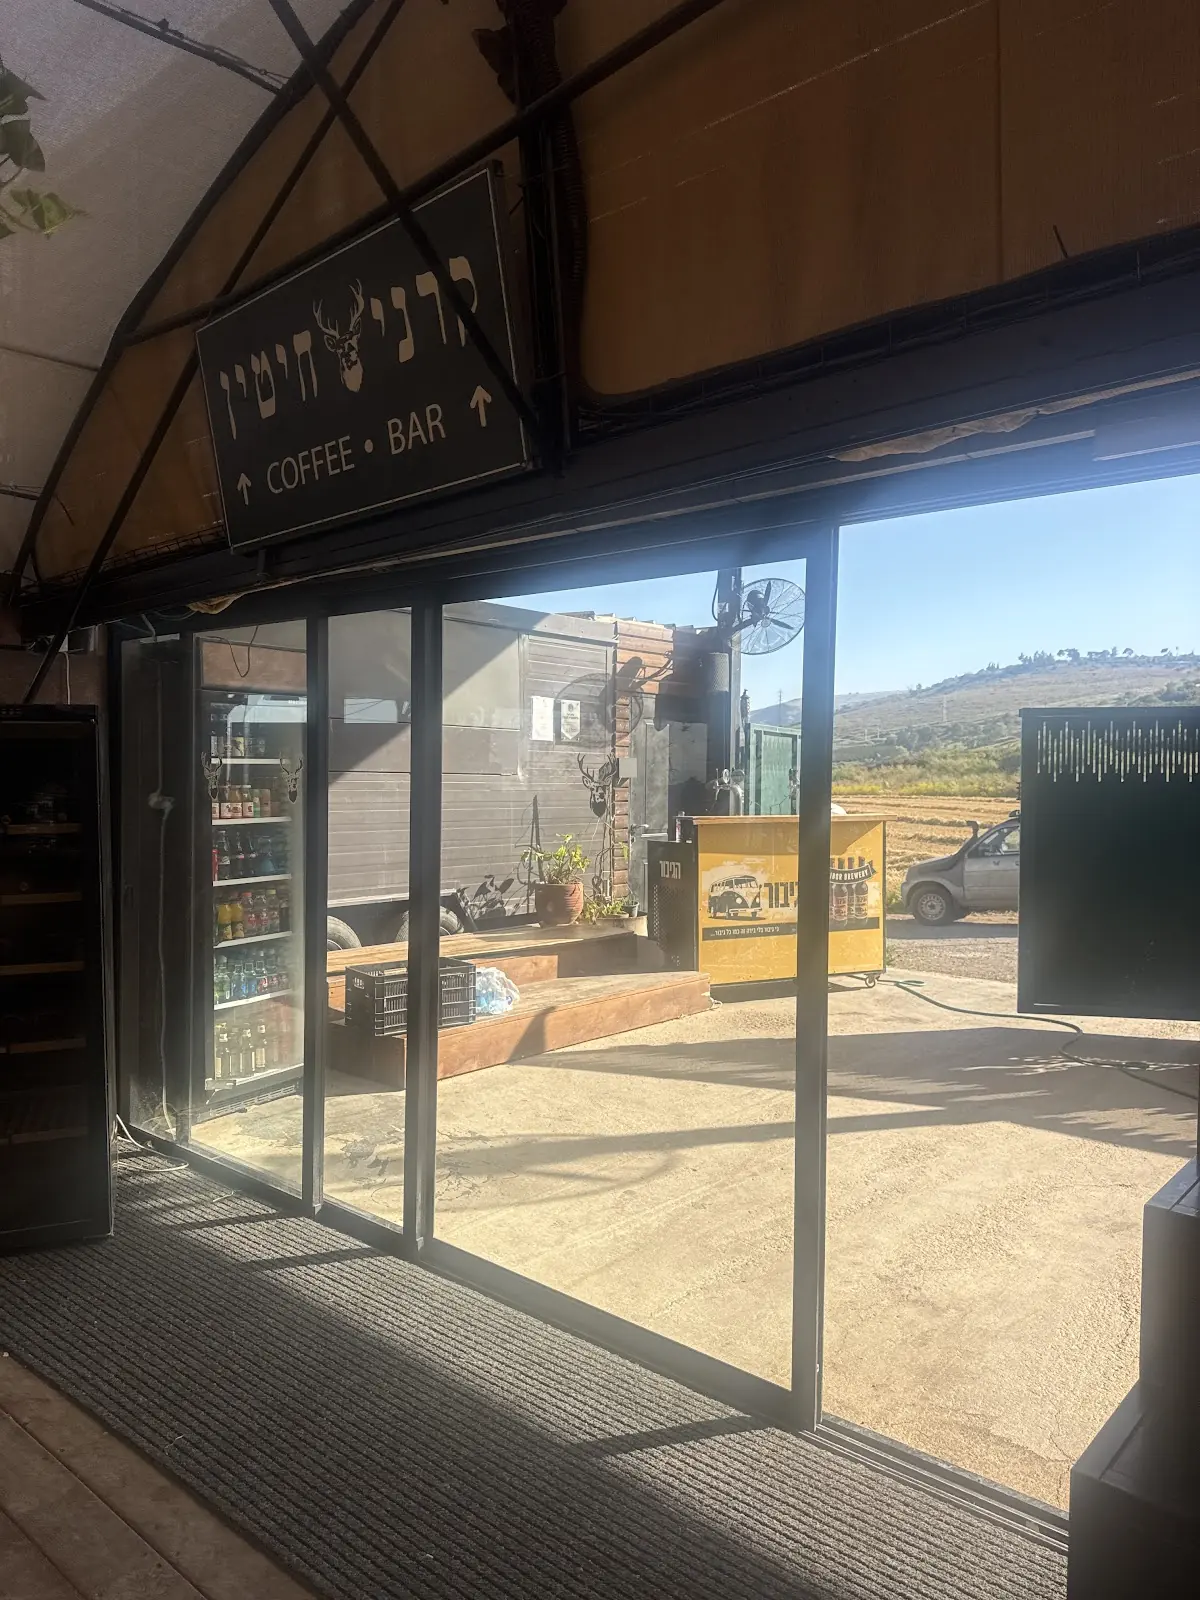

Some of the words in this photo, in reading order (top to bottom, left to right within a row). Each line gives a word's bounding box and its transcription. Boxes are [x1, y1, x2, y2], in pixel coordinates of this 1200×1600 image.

[370, 255, 479, 363] קרני
[219, 329, 318, 441] חיטין
[266, 434, 355, 495] COFFEE
[387, 403, 447, 456] BAR
[659, 860, 681, 880] הגיבור
[844, 869, 869, 881] BREWERY
